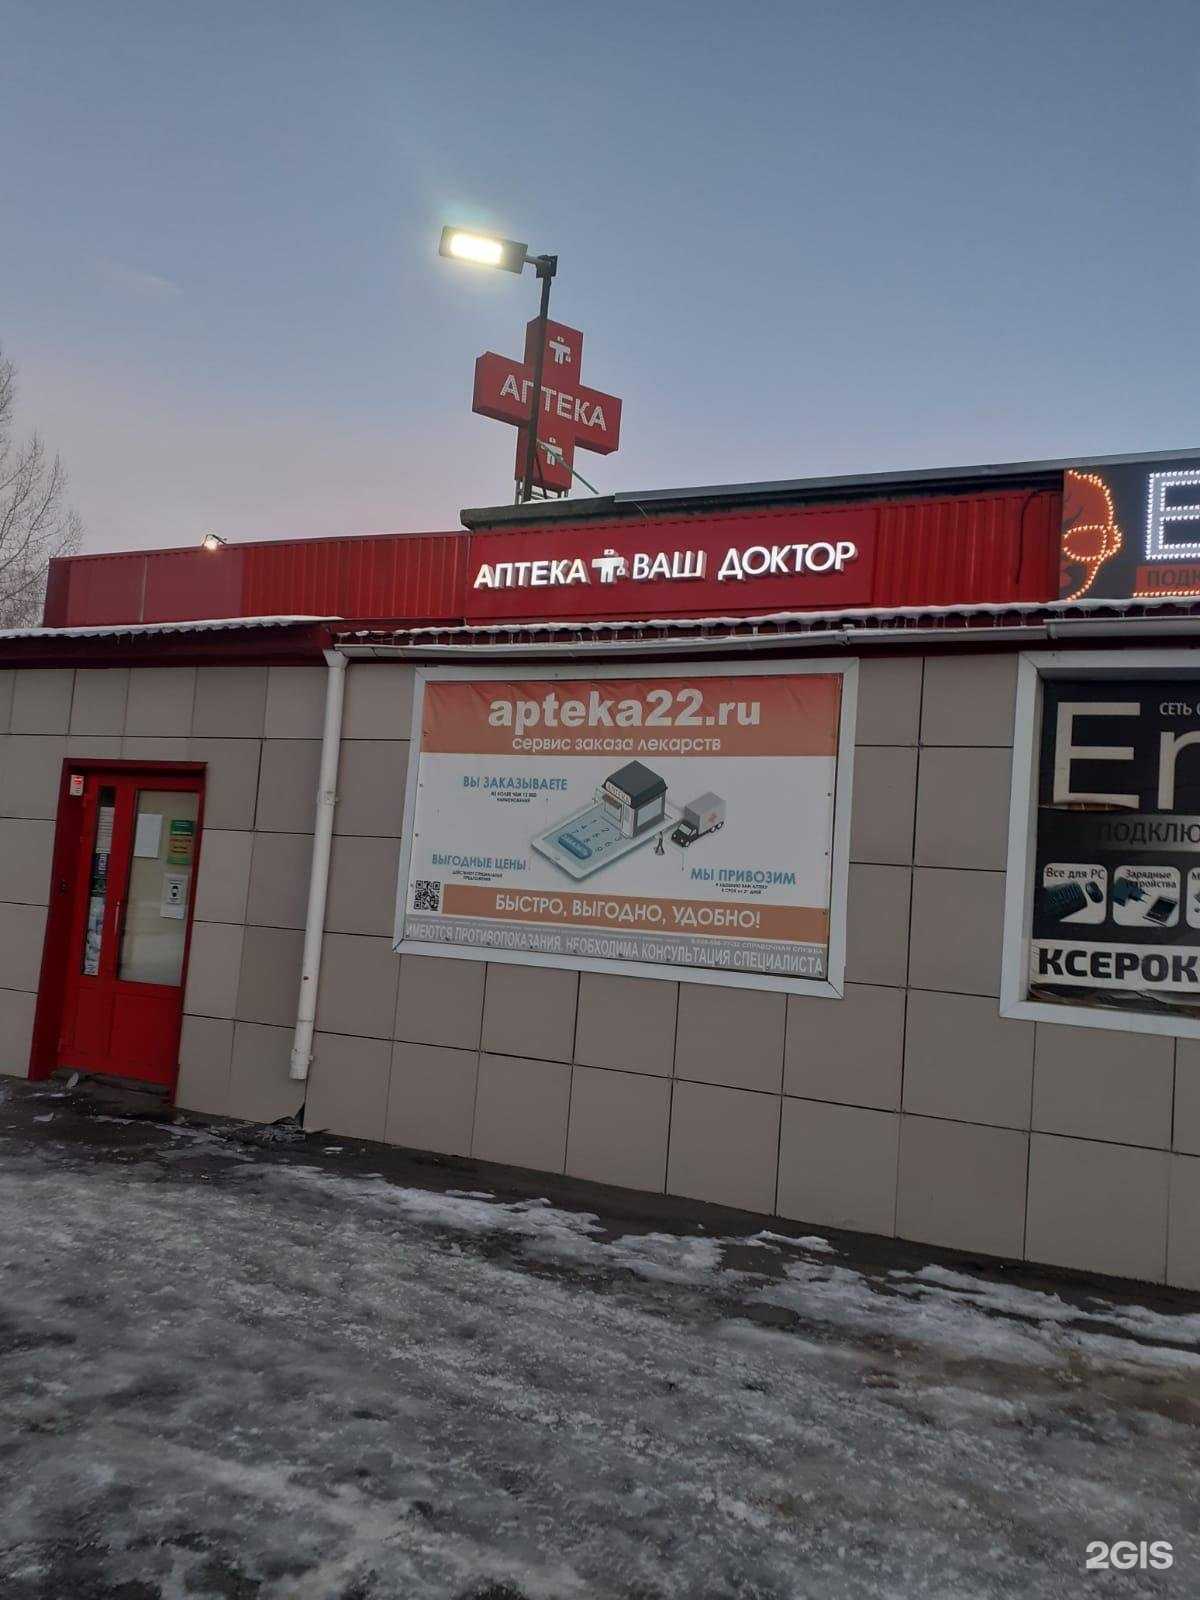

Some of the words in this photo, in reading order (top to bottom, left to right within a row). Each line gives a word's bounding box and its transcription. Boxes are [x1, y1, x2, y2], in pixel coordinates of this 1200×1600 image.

[473, 558, 590, 589] АПТЕКА
[632, 549, 706, 581] ВАШ
[716, 541, 858, 582] ДОКТОР
[488, 688, 761, 736] apteka22.ru
[1159, 702, 1193, 716] СЕТЬ
[512, 737, 571, 752] сервис
[574, 736, 633, 751] заказа
[637, 736, 721, 754] лекарств
[463, 776, 480, 789] ВЫ
[483, 776, 568, 791] ЗАКАЗЫВАЕТЕ
[432, 853, 492, 869] ВЫГОДНЫЕ
[494, 857, 527, 871] ЦЕНЫ
[690, 867, 714, 881] МЫ
[718, 869, 796, 885] ПРИВОЗИМ
[1046, 867, 1064, 879] Все
[1067, 870, 1087, 880] для
[496, 894, 567, 917] БЫСТРО,
[572, 899, 666, 925] ВЫГОДНО,
[671, 905, 761, 929] УДОБНО!
[566, 936, 639, 958] НЕОБХОДИМА
[641, 942, 730, 967] КОНСУЛЬТАЦИЯ
[733, 951, 823, 974] СПЕЦИАЛИСТА
[1038, 947, 1199, 983] КСЕРОК
